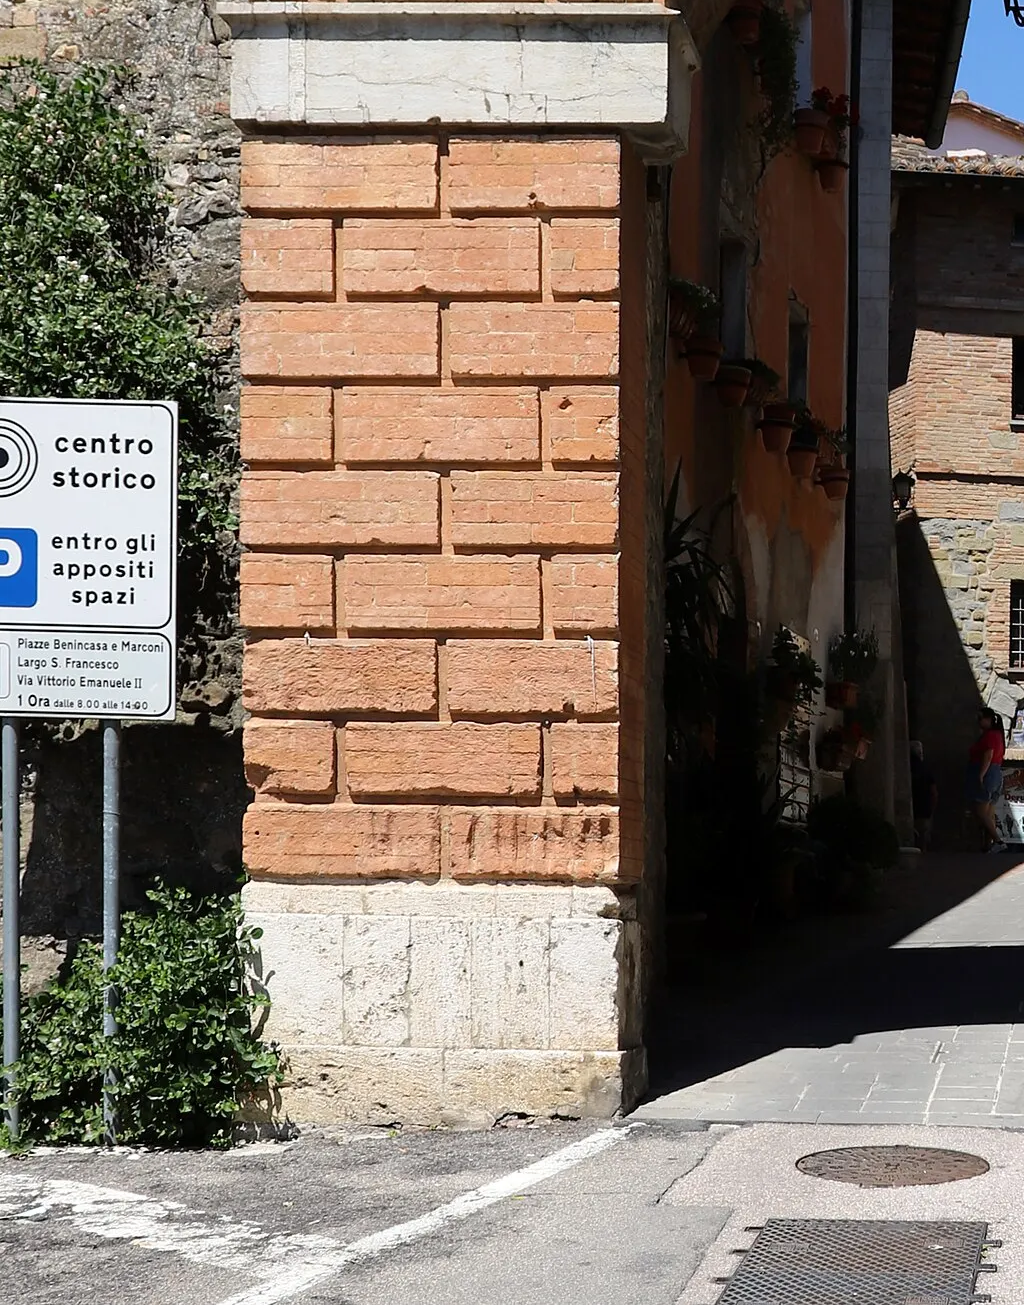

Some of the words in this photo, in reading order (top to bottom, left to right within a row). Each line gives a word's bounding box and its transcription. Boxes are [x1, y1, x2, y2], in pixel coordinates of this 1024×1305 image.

[55, 433, 153, 454] centro
[53, 467, 155, 489] storico
[52, 533, 117, 550] entro
[126, 534, 155, 554] gli
[53, 560, 153, 580] appositi
[72, 587, 134, 606] spazi
[18, 638, 49, 649] Piazze
[54, 639, 107, 650] Benincasa
[112, 643, 117, 651] e
[122, 641, 164, 653] Marconi
[18, 657, 47, 669] Largo
[51, 657, 61, 668] S.
[66, 658, 119, 669] Francesco
[18, 675, 33, 685] Via
[37, 676, 75, 686] Vittorio
[80, 677, 131, 688] Emanuele
[135, 678, 142, 688] II
[18, 694, 22, 706] 1
[28, 694, 50, 707] Ora
[54, 700, 74, 708] dalle
[78, 700, 100, 708] 8.00
[103, 701, 118, 709] alle
